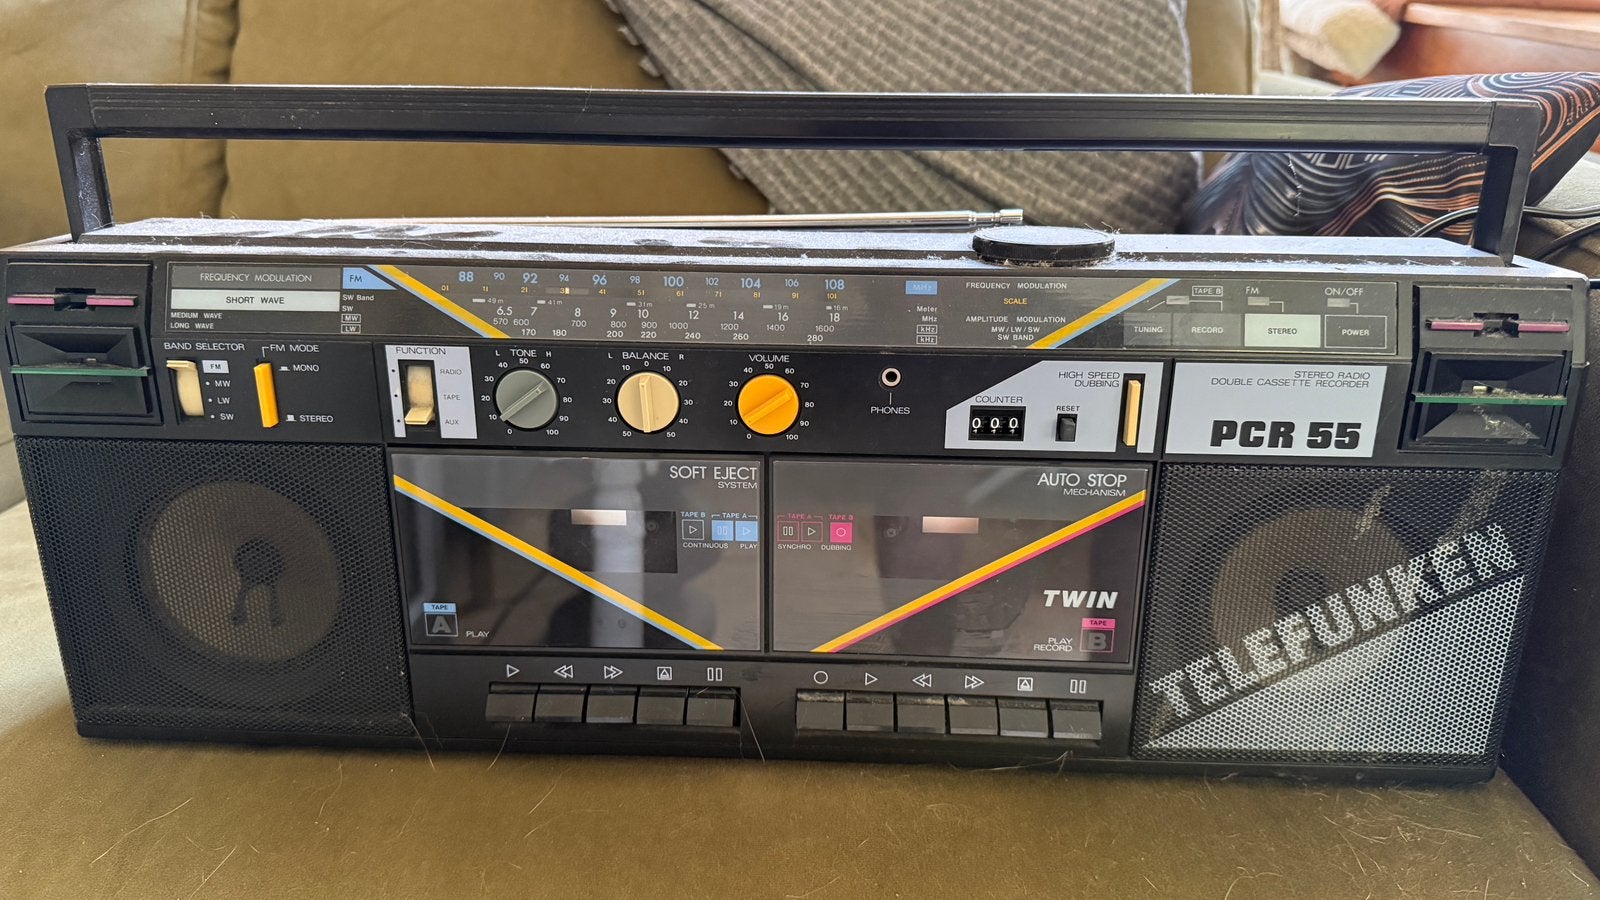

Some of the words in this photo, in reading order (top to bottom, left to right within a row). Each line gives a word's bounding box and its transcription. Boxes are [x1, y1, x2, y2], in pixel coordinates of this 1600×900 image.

[200, 273, 249, 282] FREQUENCY
[254, 274, 312, 283] MODULATION
[459, 272, 474, 282] 88
[494, 273, 505, 281] 90
[523, 273, 538, 284] 92
[559, 274, 569, 282] 94
[592, 274, 607, 285] 96
[629, 276, 640, 284] 98
[664, 277, 684, 287] 100
[705, 278, 719, 286] 102
[741, 278, 761, 289] 104
[785, 279, 799, 288] 106
[825, 279, 845, 290] 108
[1246, 287, 1259, 295] FM
[1325, 287, 1364, 296] ON/OFF
[497, 307, 513, 316] 6.5
[530, 307, 538, 316] 7
[575, 308, 581, 318] 8
[610, 309, 617, 318] 9
[638, 310, 649, 319] 10
[689, 310, 699, 320] 12
[733, 312, 744, 320] 14
[778, 313, 789, 322] 16
[830, 313, 840, 323] 18
[571, 320, 587, 328] 700
[669, 322, 688, 330] 1000
[721, 323, 739, 331] 1200
[767, 324, 785, 332] 1400
[815, 325, 835, 333] 1600
[1134, 326, 1163, 334] TUNING
[1192, 326, 1224, 334] RECORD
[641, 331, 657, 339] 220
[685, 332, 701, 340] 240
[733, 333, 749, 341] 260
[196, 343, 245, 351] SELECTOR
[396, 347, 446, 355] FUNCTION
[622, 352, 669, 361] BALANCE
[749, 355, 789, 363] VOLUME
[1059, 371, 1084, 379] HIGH
[1088, 372, 1120, 380] SPEED
[1294, 371, 1334, 379] STEREO
[1338, 372, 1371, 380] RADIO
[1075, 380, 1120, 388] DUBBING
[1211, 378, 1253, 386] DOUBLE
[1257, 378, 1311, 387] CASSETTE
[1315, 380, 1369, 388] RECORDER
[871, 407, 910, 415] PHONES
[300, 415, 334, 423] STEREO
[1210, 420, 1295, 449] PCR
[1307, 422, 1362, 450] 55
[670, 466, 707, 479] SOFT
[714, 467, 758, 481] EJECT
[1037, 473, 1080, 487] AUTO
[1087, 474, 1127, 487] STOP
[1063, 489, 1126, 497] MECHANISM
[1044, 590, 1118, 609] TWIN
[432, 616, 451, 633] A
[1149, 523, 1517, 719] TELEFUNKEN
[1048, 637, 1073, 645] PLAY
[1088, 632, 1107, 650] B
[1034, 644, 1073, 652] RECORD
